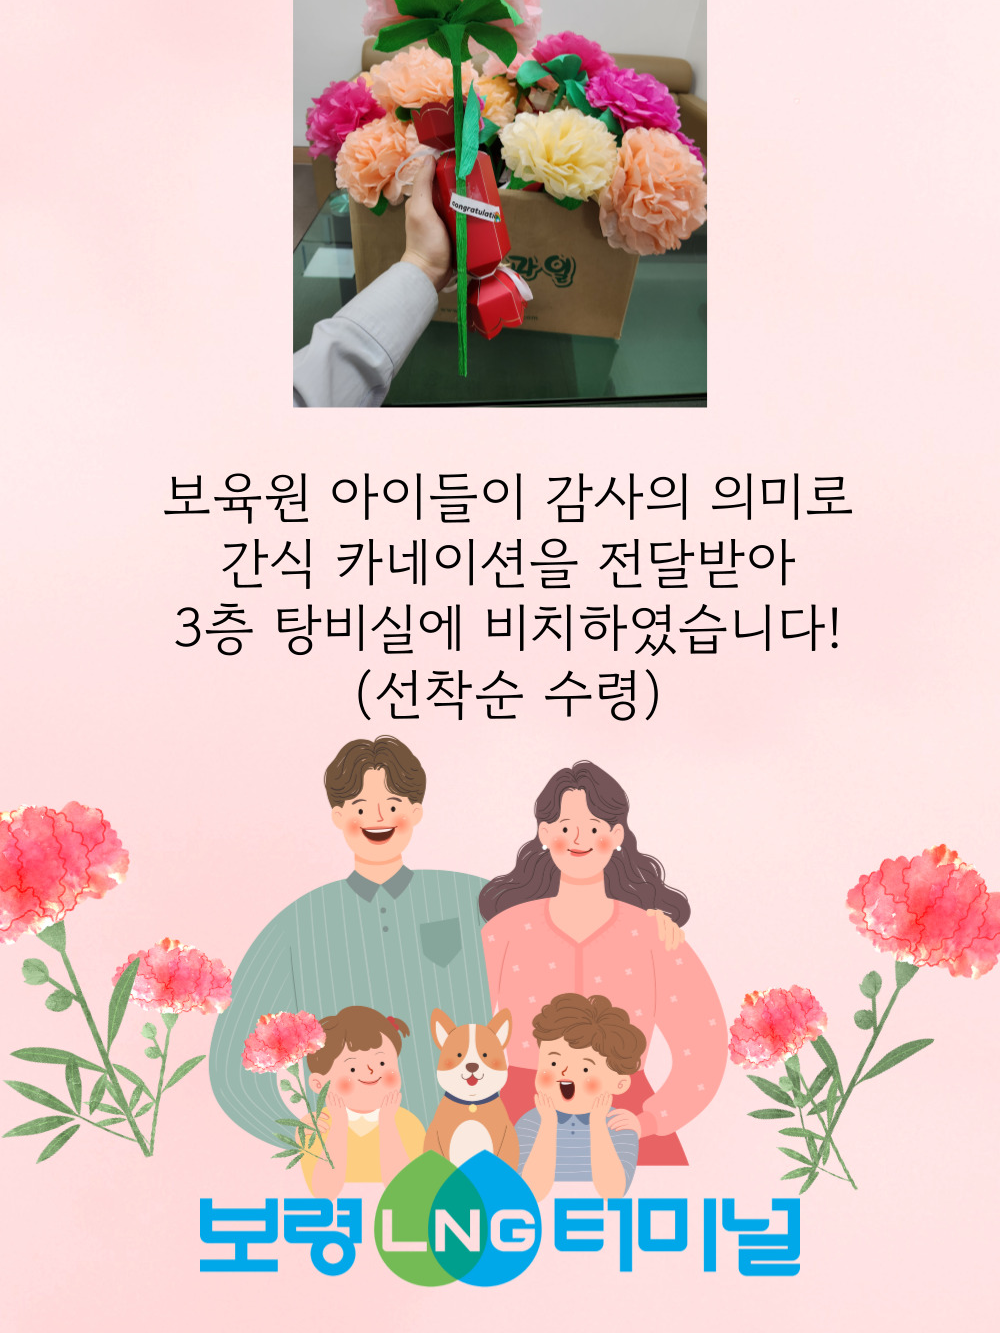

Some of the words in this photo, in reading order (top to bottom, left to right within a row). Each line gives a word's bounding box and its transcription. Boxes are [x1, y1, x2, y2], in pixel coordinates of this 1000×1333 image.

[164, 473, 309, 524] 보육원
[332, 473, 522, 523] 아이들이
[547, 473, 688, 522] 감사의
[712, 473, 853, 520] 의미로
[223, 539, 312, 589] 간식
[337, 539, 578, 588] 카네이션을
[600, 539, 796, 588] 전달받아
[175, 603, 254, 655] 3층
[277, 604, 462, 655] 탕비실에
[488, 604, 840, 656] 비치하였습니다!
[357, 669, 524, 721] (선착순
[545, 669, 660, 721] 수령)
[200, 1197, 800, 1276] 보령LNG터미널
